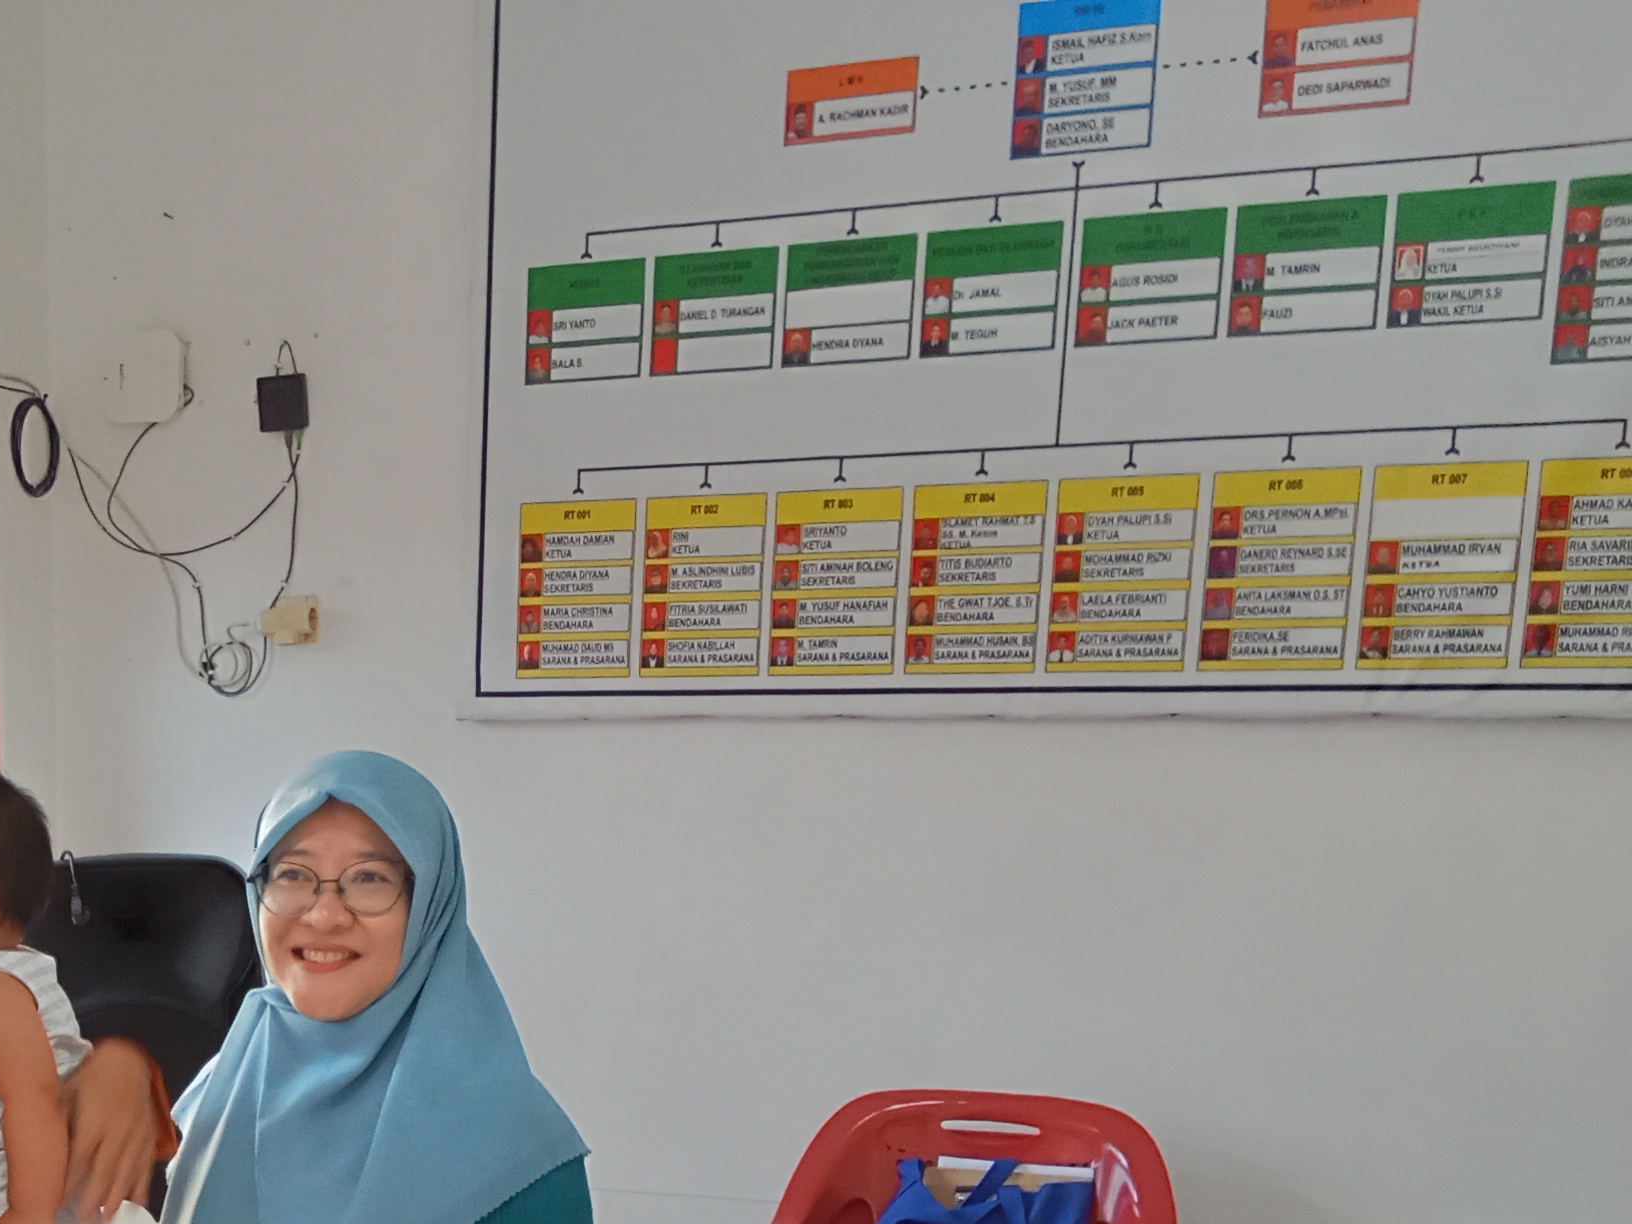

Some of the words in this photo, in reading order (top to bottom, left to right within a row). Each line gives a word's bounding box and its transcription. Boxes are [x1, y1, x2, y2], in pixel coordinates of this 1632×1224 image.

[1352, 33, 1383, 46] ANAS
[1051, 52, 1084, 65] KETUA
[1297, 84, 1323, 96] DEDI
[1326, 77, 1390, 93] SAPARWADI
[1048, 92, 1110, 108] SEKRETARIS
[879, 103, 909, 116] KADIR
[1045, 133, 1109, 149] BENDAHARA
[1281, 263, 1320, 275] TAMRIN
[1427, 263, 1457, 274] KETUA
[969, 288, 1002, 299] JAMAL
[1424, 289, 1449, 302] DYAH
[680, 310, 708, 321] DANIEL
[721, 306, 766, 318] TURANGAN
[1263, 307, 1292, 319] FAUZI
[1423, 306, 1450, 317] WAKIL
[1453, 304, 1484, 316] KETUA
[554, 321, 567, 331] SRI
[569, 318, 596, 330] YANTO
[1109, 318, 1135, 329] JACK
[1137, 315, 1178, 327] PAETER
[964, 329, 998, 340] TEGUH
[812, 339, 850, 350] HENDRA
[552, 358, 575, 368] BALA
[1601, 468, 1616, 479] RT
[1432, 474, 1445, 485] RT
[1449, 473, 1468, 484] 007
[1269, 480, 1283, 491] RT
[1111, 487, 1124, 497] RT
[964, 493, 977, 503] RT
[823, 500, 835, 509] RT
[838, 499, 853, 509] 003
[1574, 500, 1614, 510] AHMAD
[564, 510, 575, 520] RT
[576, 510, 591, 519] 001
[691, 505, 701, 515] RT
[704, 505, 718, 514] 002
[1572, 515, 1609, 525] KETUA
[1243, 525, 1276, 534] KETUA
[545, 535, 581, 546] HAMDAH
[582, 534, 615, 545] DAMIAN
[1087, 530, 1119, 540] KETUA
[672, 545, 700, 554] KETUA
[802, 541, 832, 550] KETUA
[1403, 544, 1465, 555] MUHAMMAD
[1468, 543, 1501, 554] IRVAN
[1569, 540, 1587, 551] RIA
[545, 549, 572, 559] KETUA
[1085, 554, 1144, 564] MOHAMMAD
[802, 564, 817, 574] SITI
[820, 563, 854, 572] AMINAH
[856, 561, 893, 572] BOLENG
[964, 557, 1012, 569] BUDIARTO
[1239, 563, 1295, 573] SEKRETARIS
[1402, 560, 1440, 568] KETUA
[544, 571, 578, 581] HENDRA
[579, 570, 610, 580] DIYANA
[939, 572, 997, 582] SEKRETARIS
[1083, 568, 1144, 578] SEKRETARIS
[671, 580, 722, 590] SEKRETARIS
[801, 576, 855, 586] SEKRETARIS
[544, 583, 594, 593] SEKRETARIS
[1399, 587, 1435, 598] CAHYO
[1438, 586, 1498, 597] YUSTIANTO
[1564, 584, 1591, 595] YUMI
[1594, 584, 1628, 595] HARNI
[1115, 593, 1167, 604] FEBRIANTI
[1237, 591, 1262, 601] ANITA
[811, 602, 841, 611] YUSUF
[843, 600, 888, 610] HANAFIAH
[939, 599, 954, 608] THE
[958, 598, 984, 607] GWAT
[1396, 602, 1462, 612] BENDAHARA
[1563, 601, 1631, 611] BENDAHARA
[544, 608, 569, 617] MARIA
[571, 606, 613, 616] CHRISTINA
[669, 605, 695, 614] FITRIA
[1081, 609, 1141, 618] BENDAHARA
[1235, 606, 1291, 615] BENDAHARA
[799, 616, 854, 625] BENDAHARA
[937, 612, 994, 622] BENDAHARA
[543, 620, 594, 630] BENDAHARA
[669, 618, 721, 627] BENDAHARA
[1394, 629, 1426, 640] BERRY
[1428, 629, 1484, 639] RAHMAWAN
[1560, 627, 1618, 637] MUHAMMAD
[808, 639, 837, 648] TAMRIN
[936, 638, 984, 647] MUHAMMAD
[1079, 635, 1108, 644] ADITYA
[1111, 634, 1164, 643] KURNIAWAN
[668, 642, 695, 651] SHOFIA
[1232, 647, 1269, 656] SARANA
[1281, 646, 1338, 655] PRASARANA
[1393, 645, 1431, 654] SARANA
[1443, 643, 1502, 653] PRASARANA
[1559, 642, 1598, 652] SARANA
[797, 653, 829, 662] SARANA
[839, 652, 889, 661] PRASARANA
[935, 651, 969, 660] SARANA
[979, 649, 1030, 659] PRASARANA
[1078, 649, 1113, 658] SARANA
[1124, 647, 1178, 657] PRASARANA
[542, 657, 571, 665] SARANA
[580, 655, 626, 665] PRASARANA
[668, 655, 698, 663] SARANA
[708, 654, 754, 663] PRASARANA
